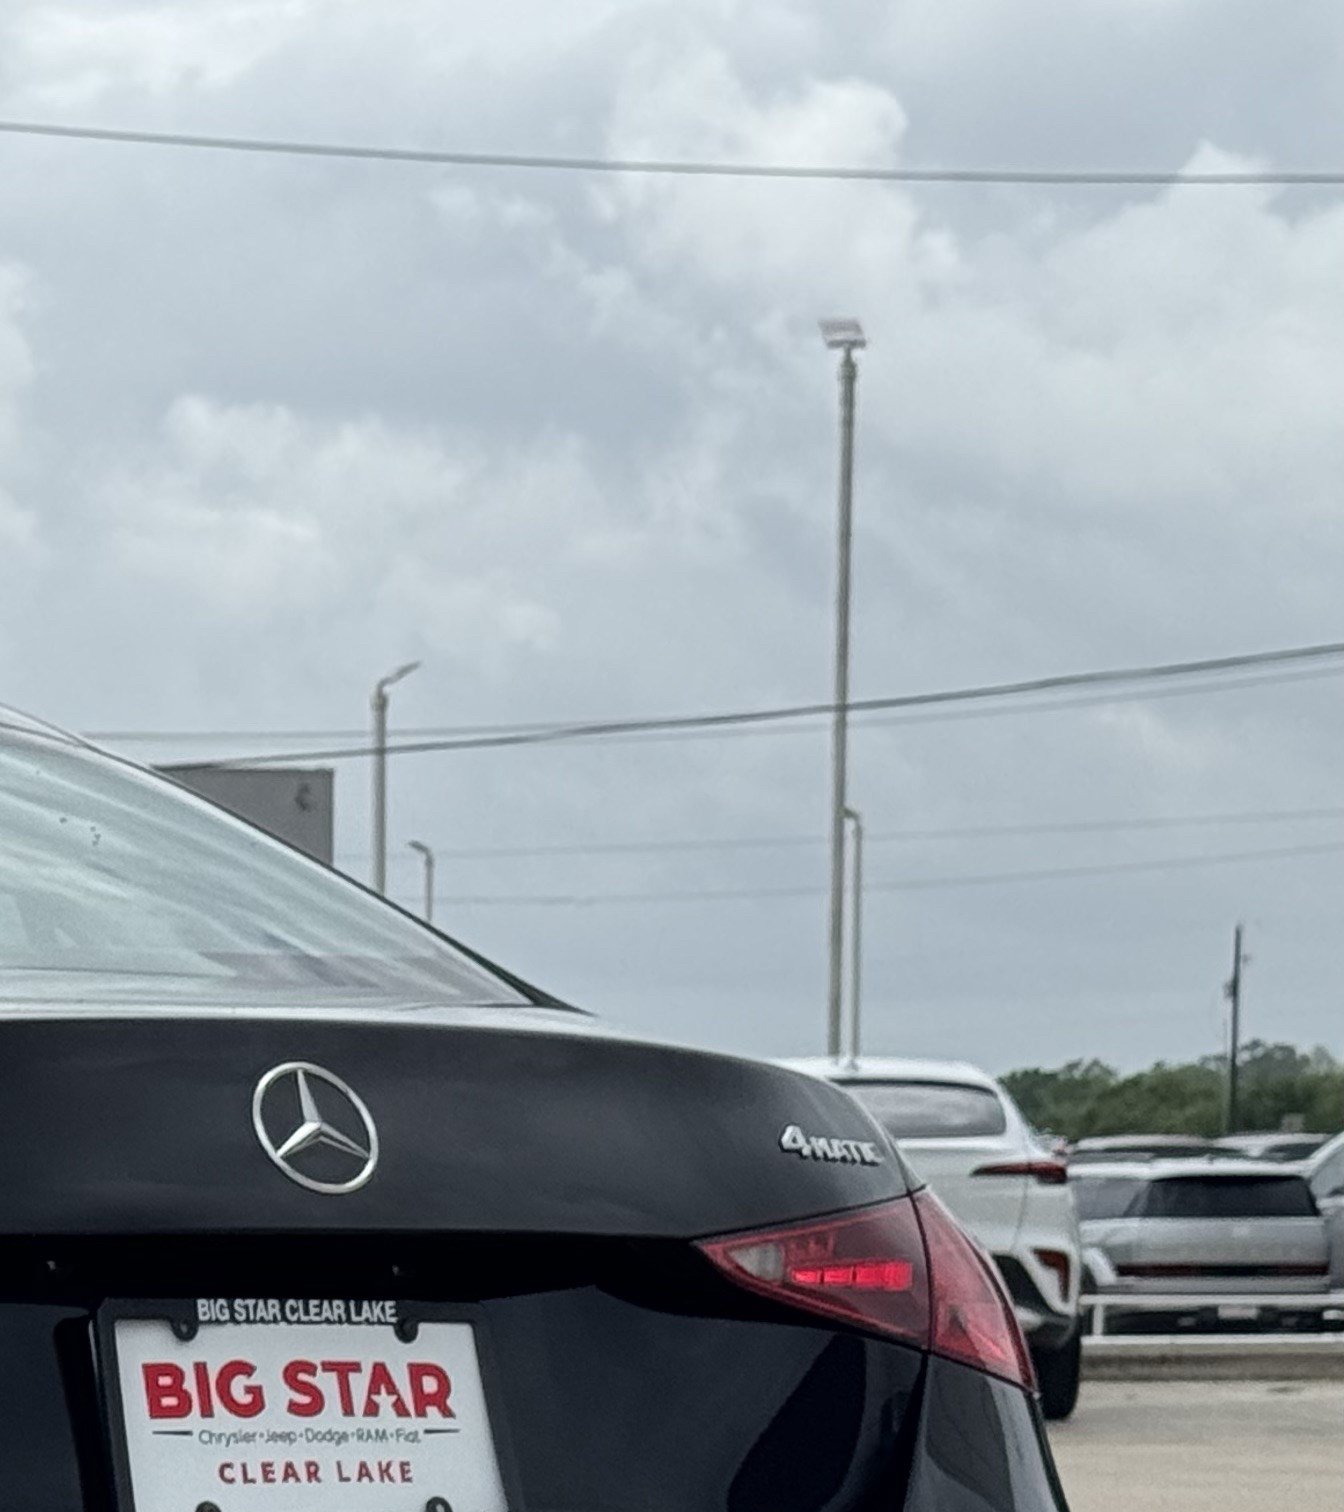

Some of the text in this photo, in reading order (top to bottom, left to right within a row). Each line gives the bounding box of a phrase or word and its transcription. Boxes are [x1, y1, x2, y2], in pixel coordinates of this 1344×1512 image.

[780, 1125, 883, 1165] 4MATIC
[197, 1299, 398, 1323] BIG STAR CLEAR LAKE
[142, 1360, 456, 1419] BIG STAR
[218, 1460, 413, 1484] CLEAR LAKE
